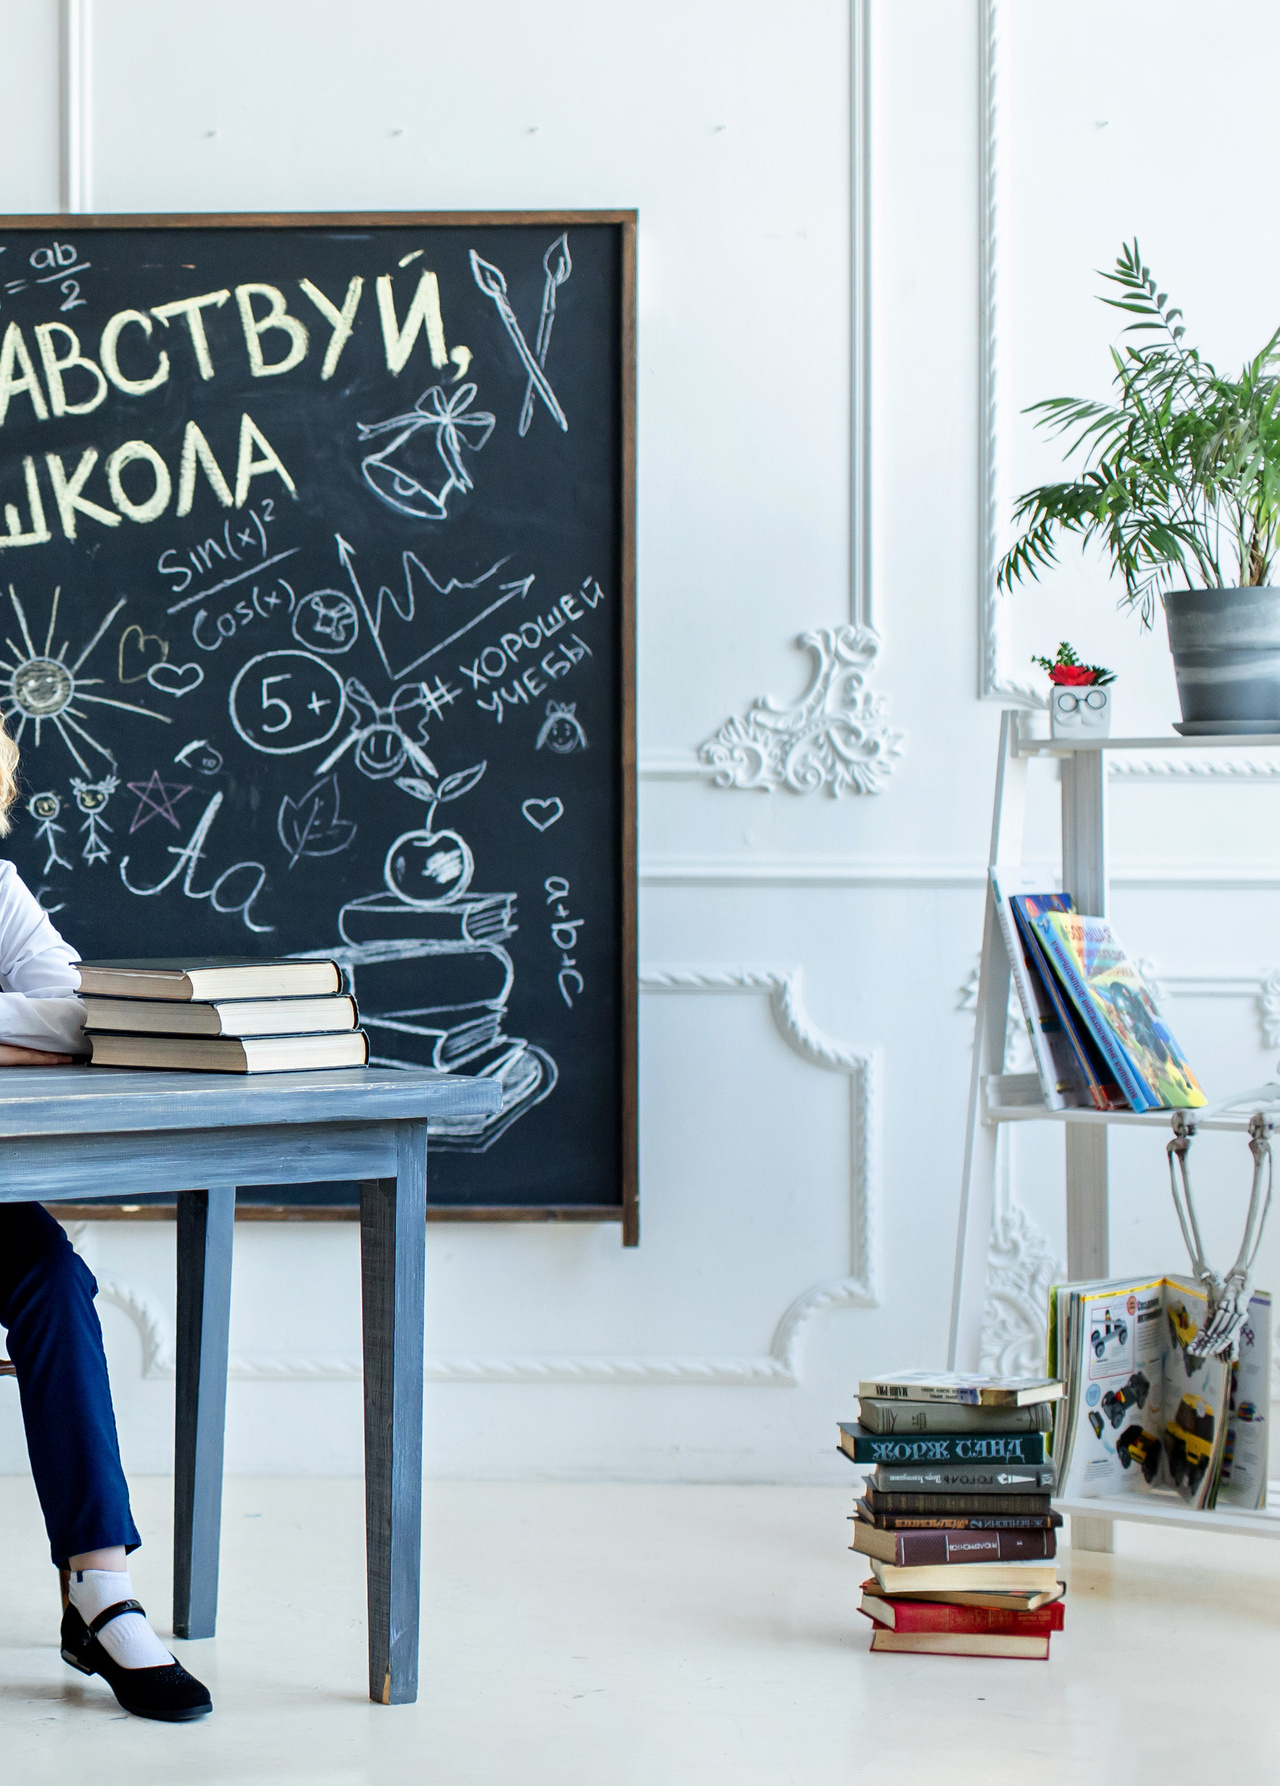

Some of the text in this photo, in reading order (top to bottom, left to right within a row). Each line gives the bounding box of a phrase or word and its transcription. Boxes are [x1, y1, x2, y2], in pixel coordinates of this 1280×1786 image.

[458, 575, 607, 692] ХОРОШЕЙ
[260, 673, 332, 733] 5+
[476, 633, 594, 723] УЧЕБЫ
[871, 1437, 1025, 1464] ЖОРЖ САНД
[942, 1474, 994, 1486] ГОГОЛЬ
